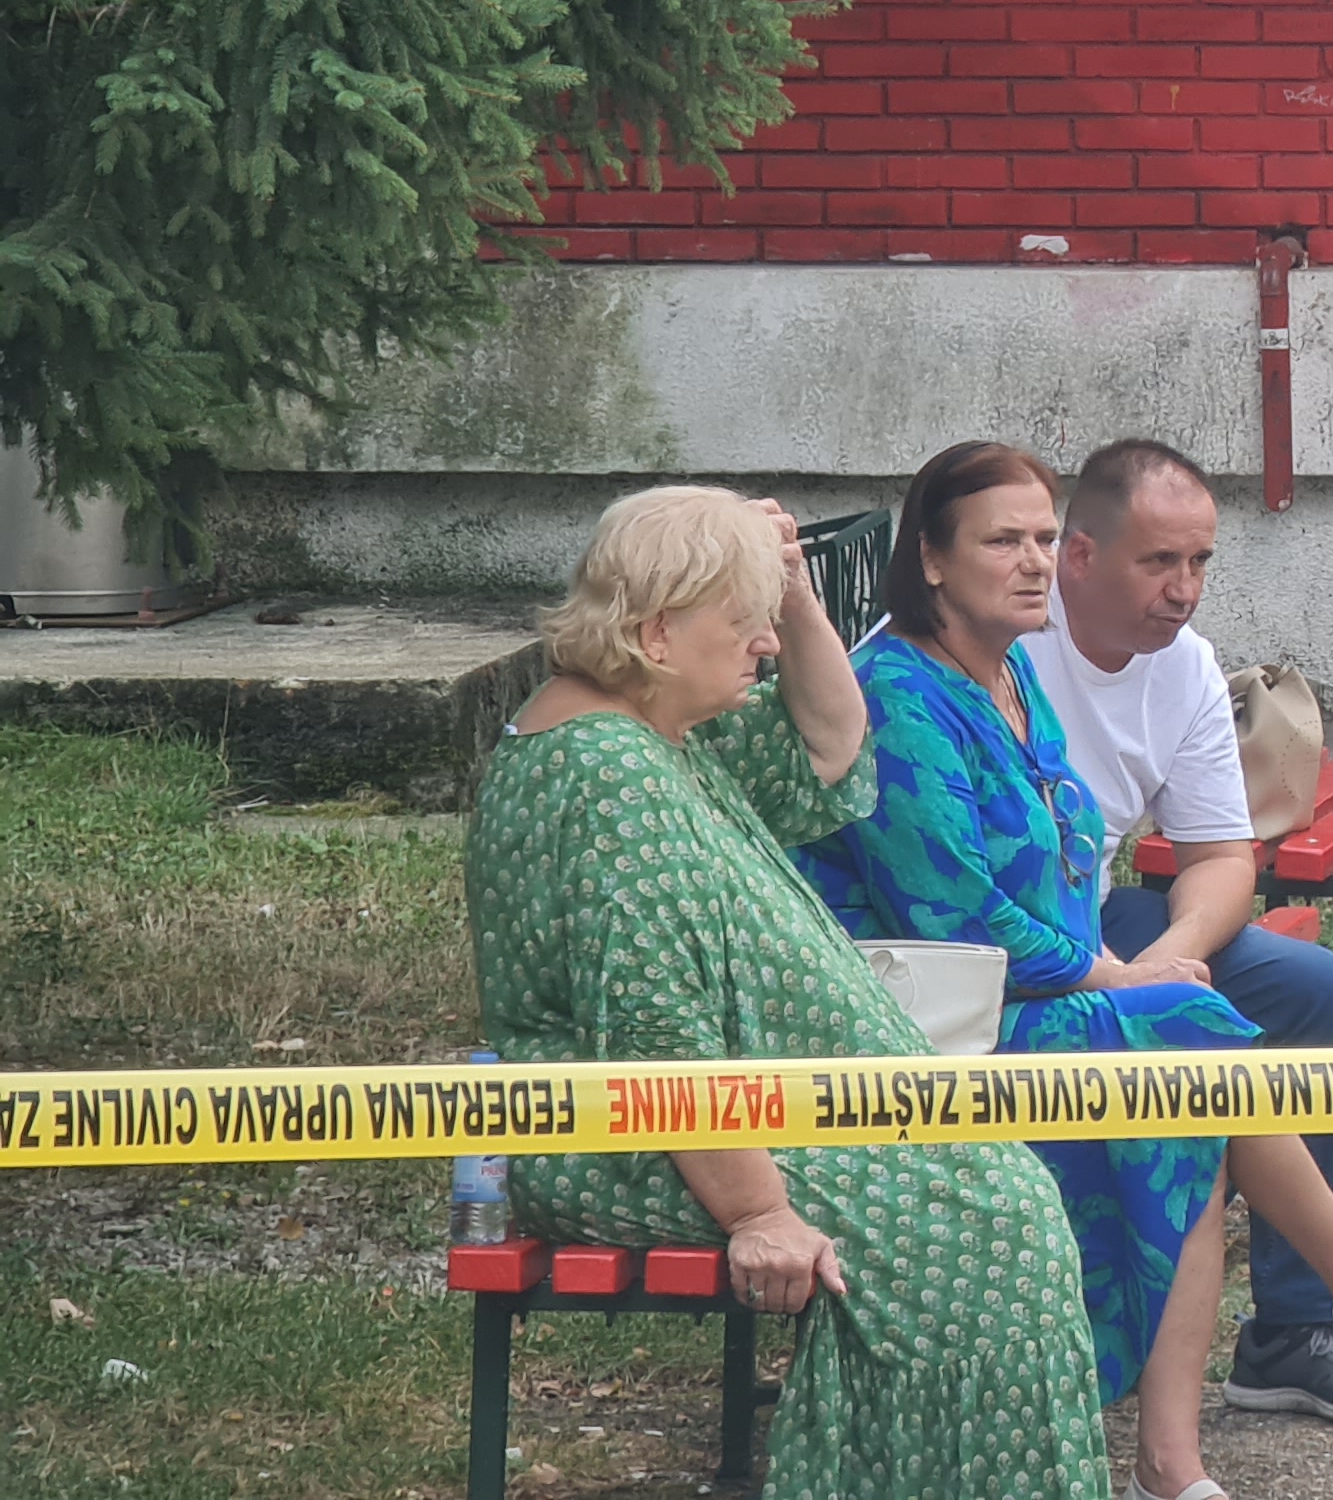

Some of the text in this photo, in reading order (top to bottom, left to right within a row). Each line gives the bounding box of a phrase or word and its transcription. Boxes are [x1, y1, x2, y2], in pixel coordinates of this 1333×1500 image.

[52, 1087, 199, 1148] CIVILNE
[208, 1084, 354, 1144] UPRAVA
[363, 1078, 575, 1140] FEDERALNA
[607, 1077, 697, 1134] MINE
[708, 1075, 786, 1131] PAZI
[813, 1072, 960, 1141] ZAŠTITE
[969, 1067, 1108, 1125] CIVILNE
[1115, 1066, 1256, 1121] UPRAVA
